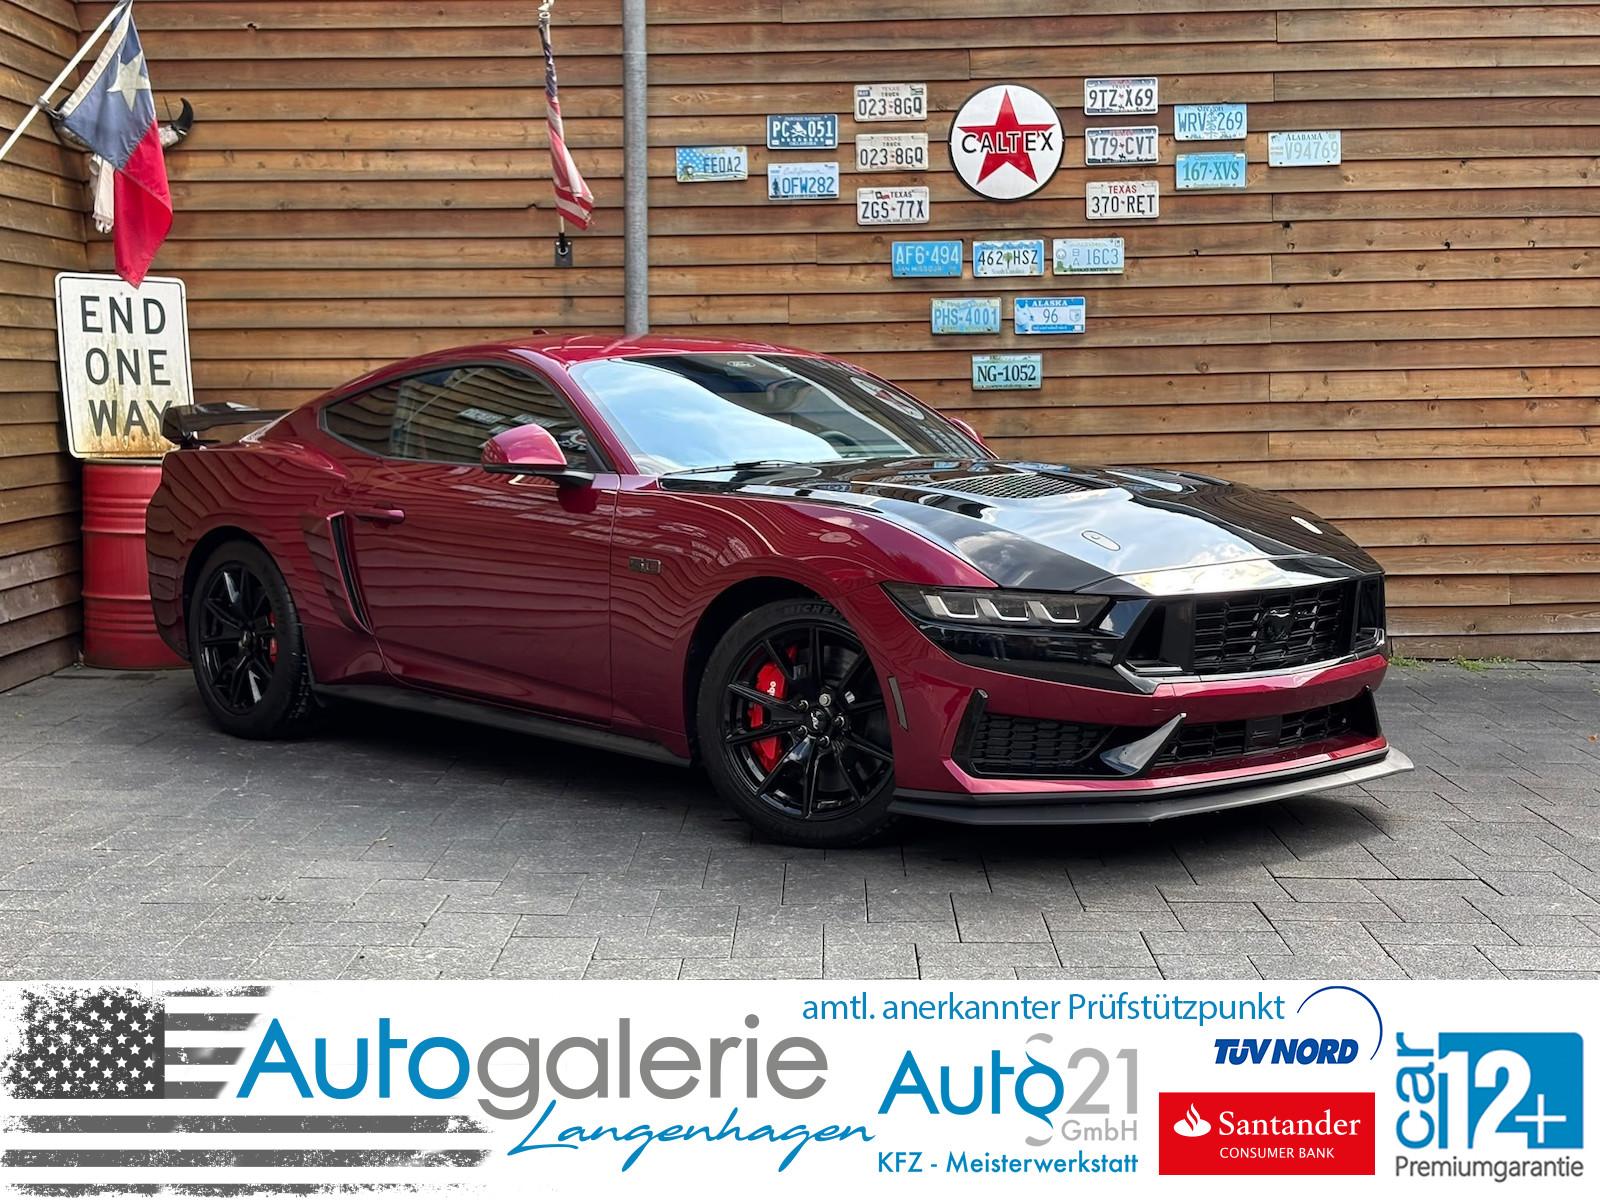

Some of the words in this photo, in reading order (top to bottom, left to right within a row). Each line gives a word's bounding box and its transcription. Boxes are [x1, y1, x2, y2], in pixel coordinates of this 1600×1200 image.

[772, 120, 790, 138] PC
[807, 120, 834, 138] 051
[1177, 111, 1207, 132] WRV
[1217, 111, 1243, 131] 269
[961, 132, 1054, 154] CALTEX
[890, 191, 913, 199] TEXAS
[1108, 185, 1137, 194] TEXAS
[977, 250, 1003, 266] 462
[1013, 249, 1038, 265] HSZ
[1032, 299, 1068, 307] ALASKA
[80, 295, 166, 335] END
[1042, 308, 1059, 324] 96
[85, 347, 171, 386] ONE
[976, 364, 1037, 382] NG-1052
[88, 399, 172, 437] WAY
